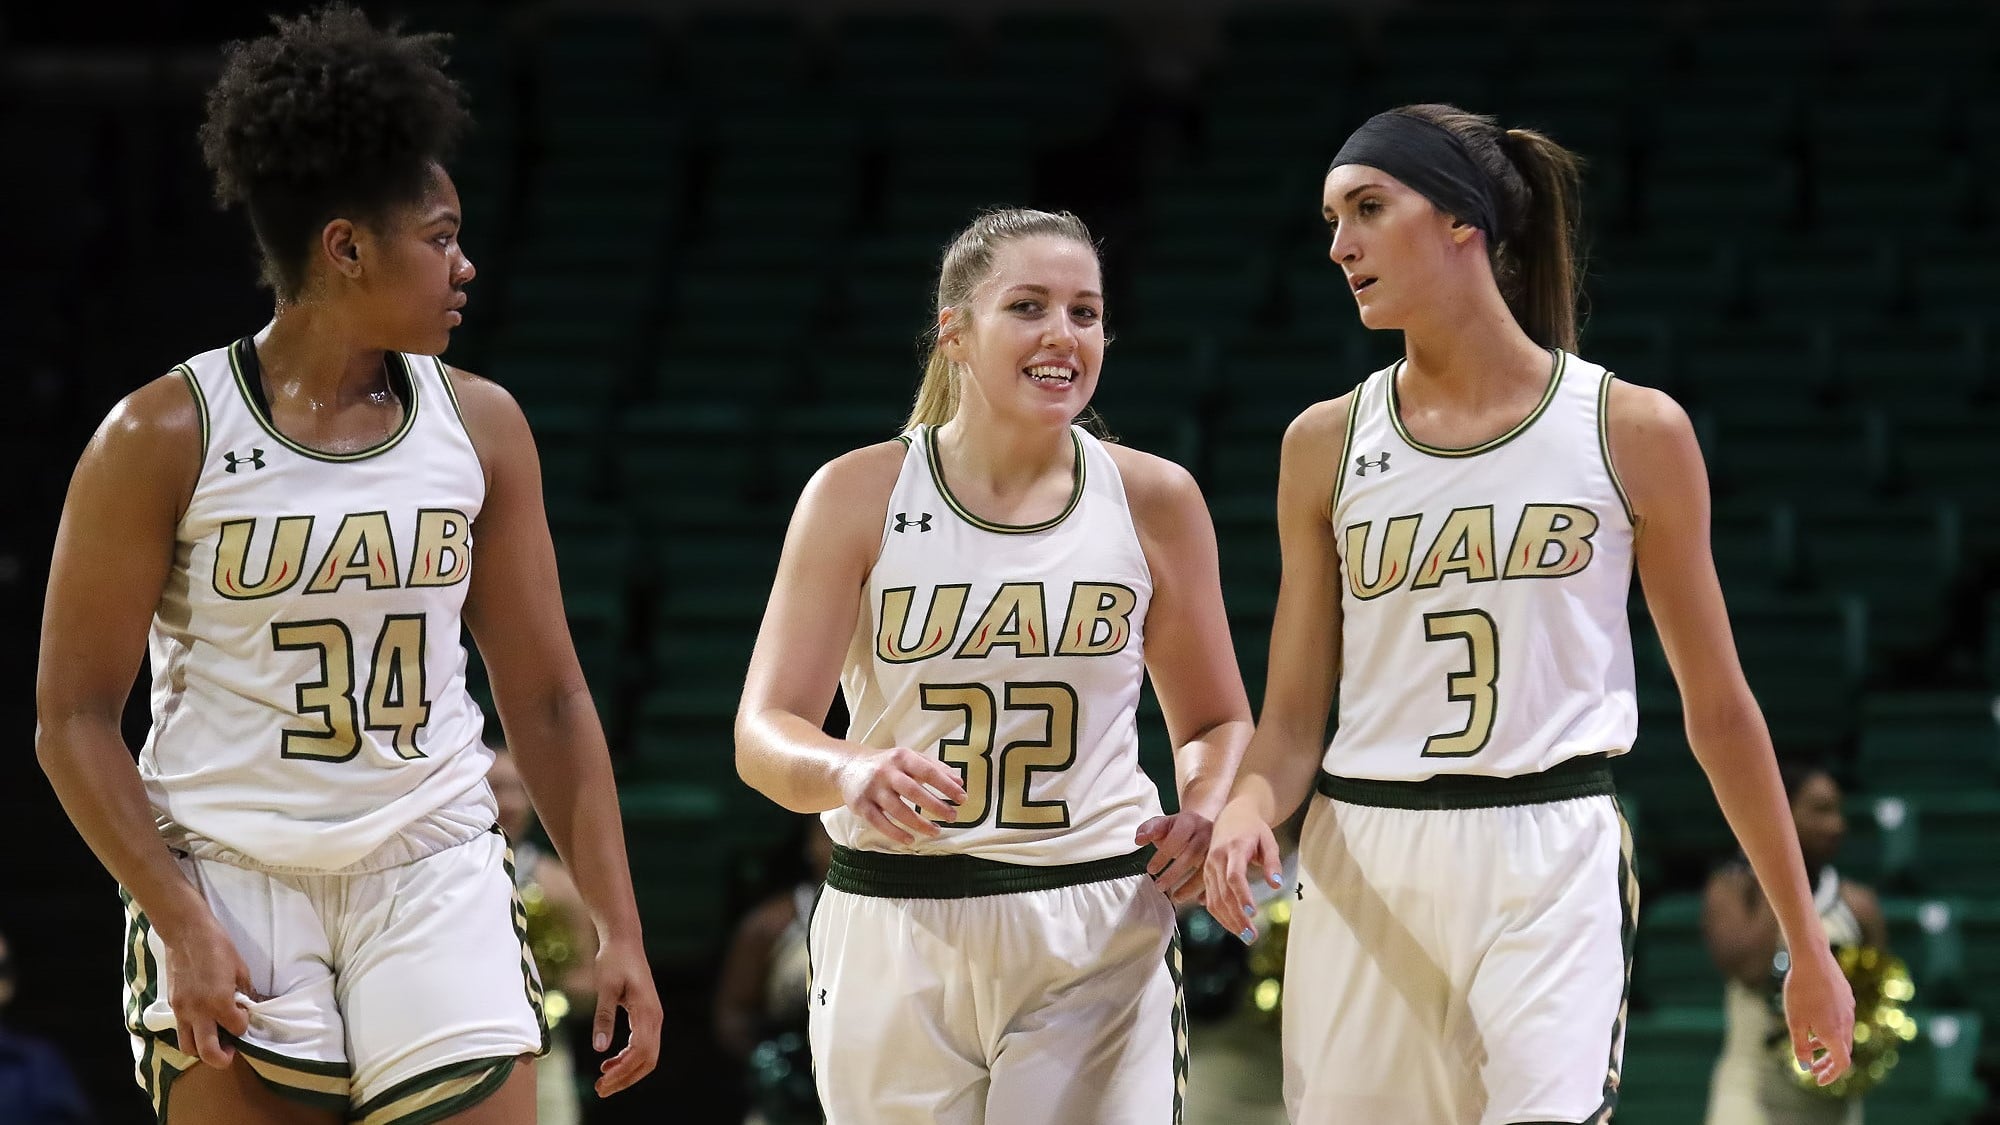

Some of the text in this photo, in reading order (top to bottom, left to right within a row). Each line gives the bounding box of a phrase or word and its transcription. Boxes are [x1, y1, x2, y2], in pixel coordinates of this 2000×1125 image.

[212, 508, 470, 600] UAB
[1345, 503, 1599, 601] UAB
[876, 581, 1137, 664] UAB
[1420, 608, 1500, 758] 3
[271, 612, 432, 763] 34
[914, 681, 1078, 829] 32
